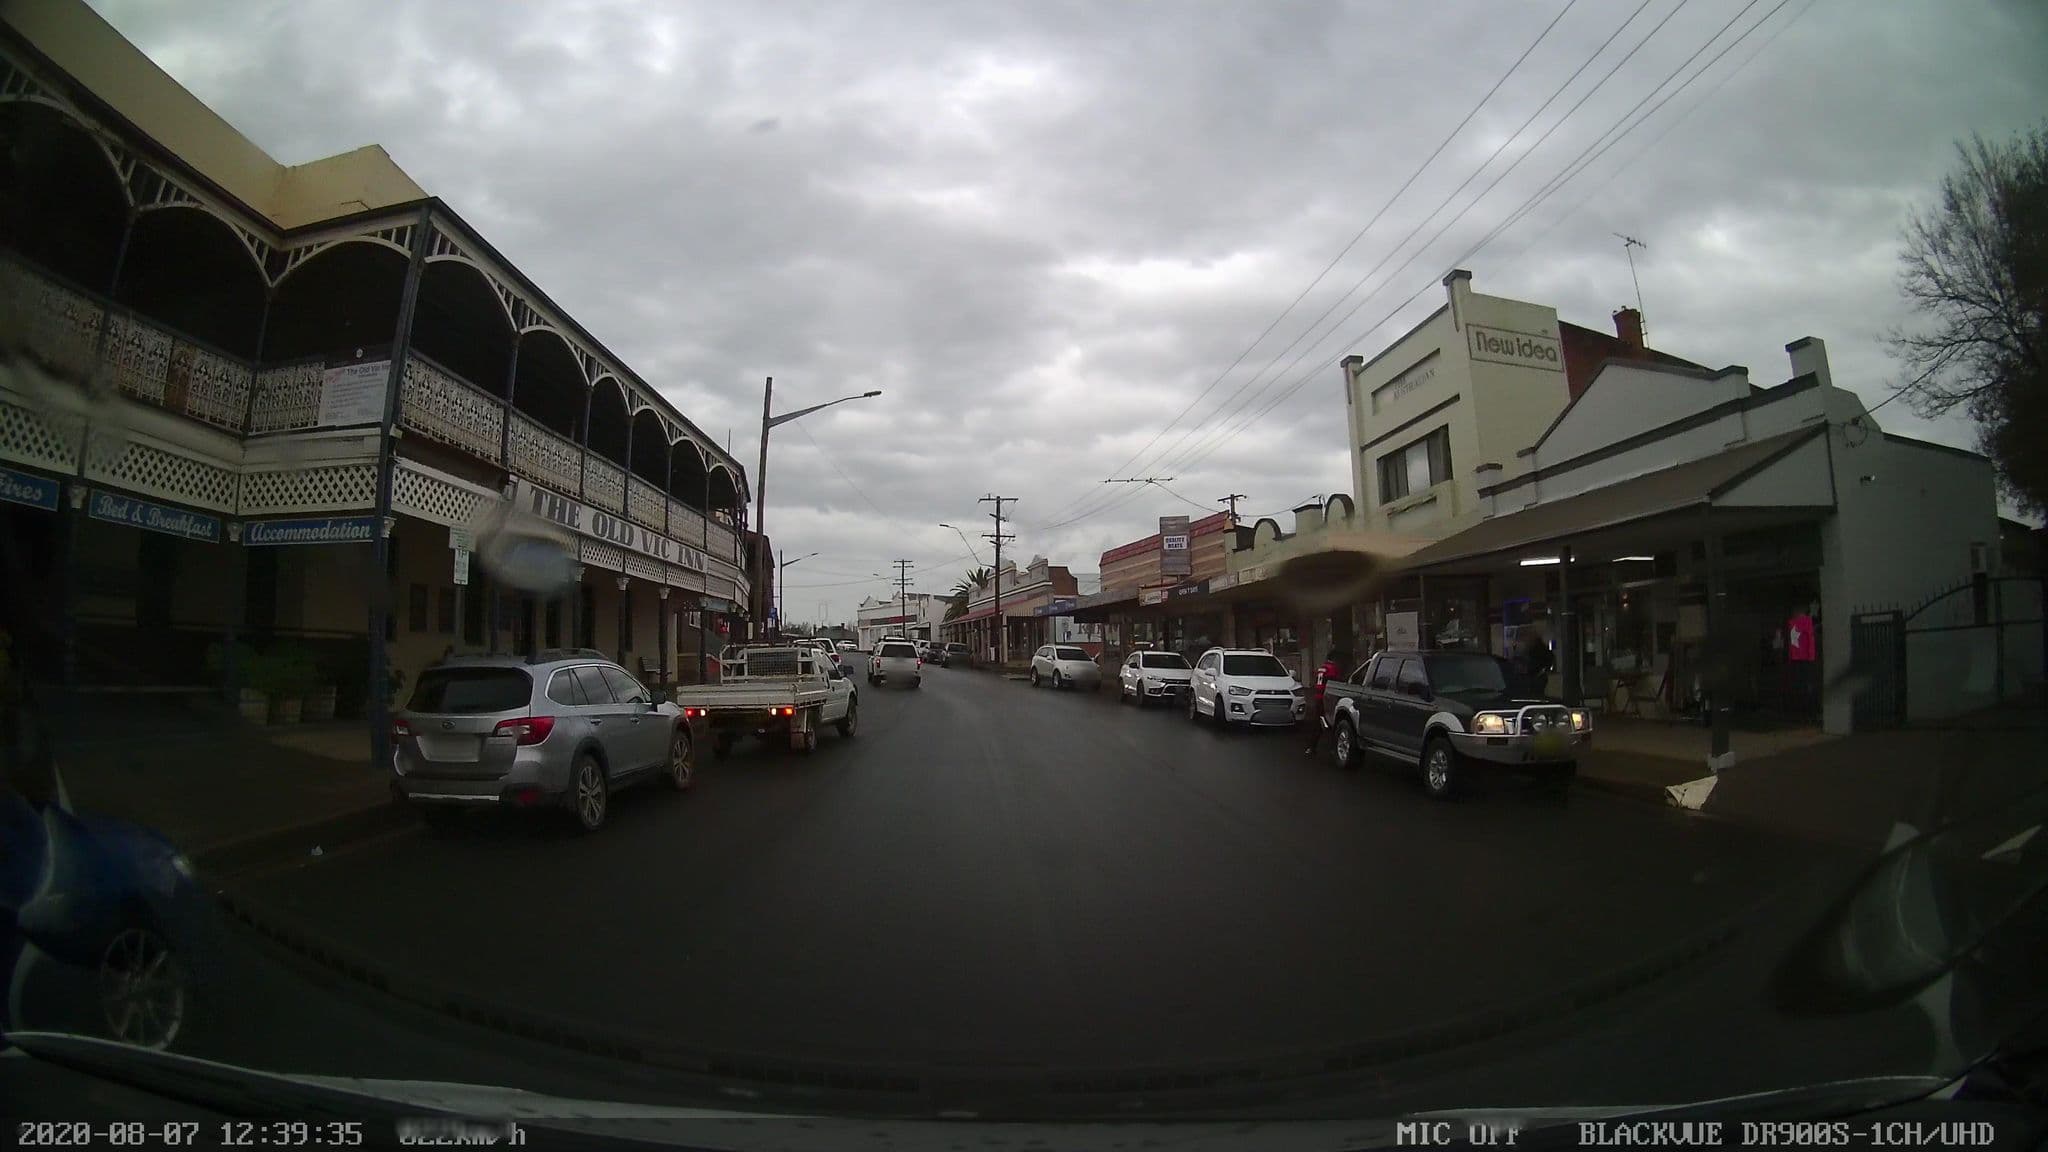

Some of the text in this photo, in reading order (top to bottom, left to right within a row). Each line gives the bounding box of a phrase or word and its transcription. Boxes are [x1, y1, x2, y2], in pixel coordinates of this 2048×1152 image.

[97, 495, 212, 538] Bed & Breakfast
[251, 520, 371, 542] Accommodation
[530, 485, 706, 571] THE OLD VIC INN
